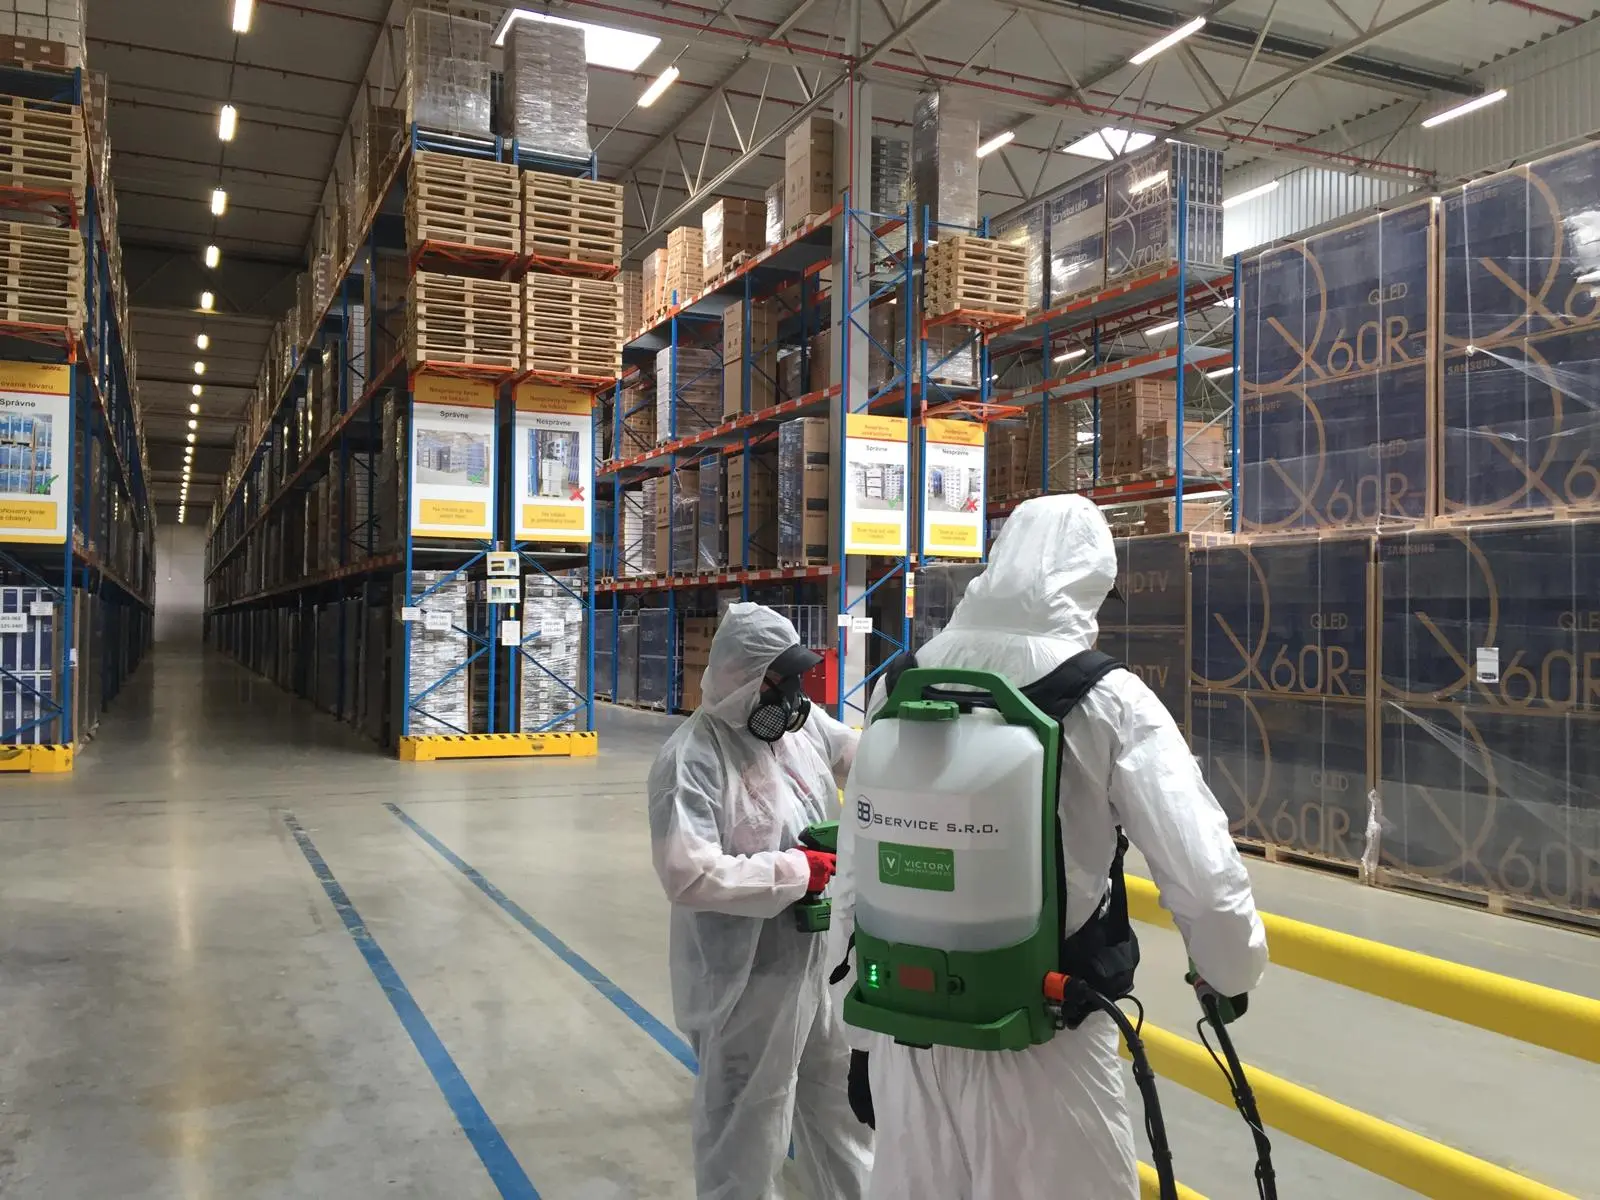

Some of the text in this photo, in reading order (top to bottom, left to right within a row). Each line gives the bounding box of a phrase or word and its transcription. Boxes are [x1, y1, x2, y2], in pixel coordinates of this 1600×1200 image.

[1368, 283, 1408, 305] QLED
[1447, 359, 1498, 376] SAMSUNG
[439, 410, 469, 419] Správne
[1310, 612, 1349, 630] QLED
[904, 860, 951, 871] VICTORY
